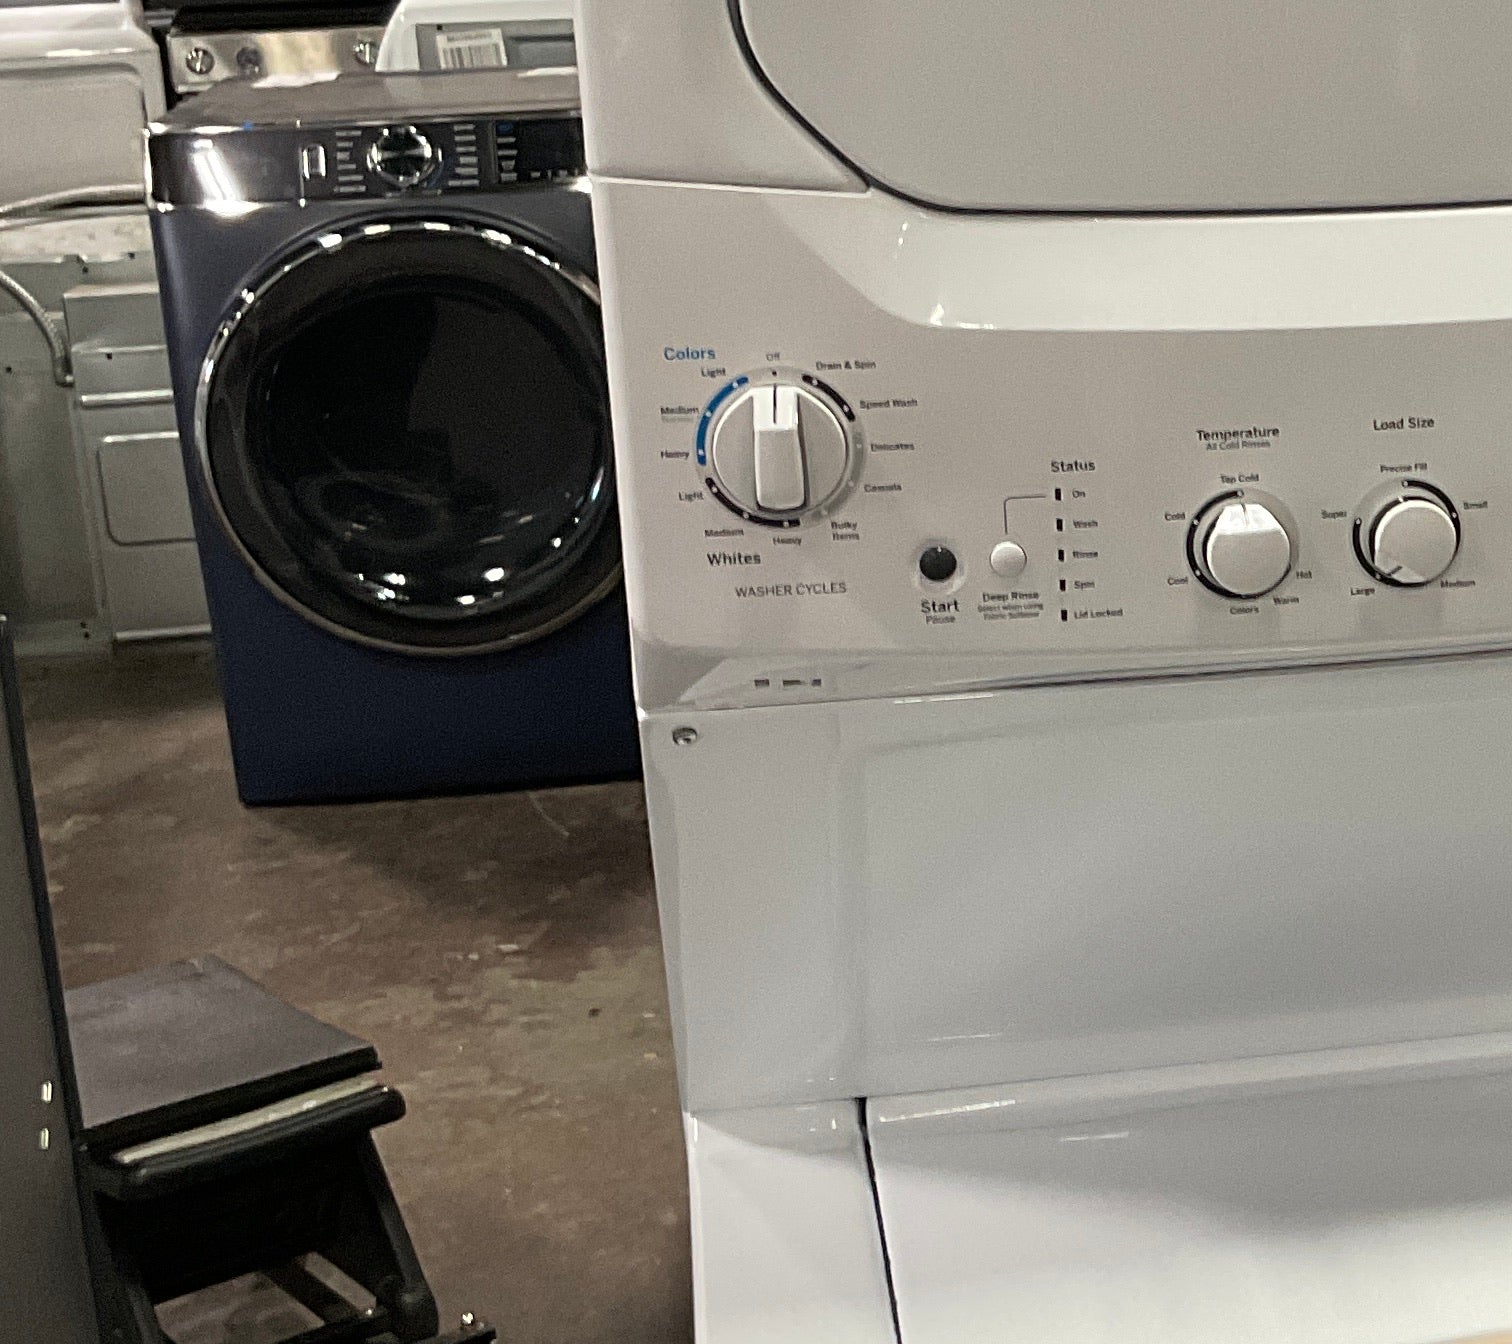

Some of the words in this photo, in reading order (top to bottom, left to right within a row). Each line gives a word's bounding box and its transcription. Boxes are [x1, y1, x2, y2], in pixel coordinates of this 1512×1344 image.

[664, 346, 716, 361] Colors
[1373, 418, 1404, 431] Load
[1408, 417, 1435, 429] Size
[1197, 426, 1280, 442] Temperature
[1051, 460, 1096, 473] Status
[1072, 488, 1086, 498] On
[707, 552, 762, 566] Whites
[736, 585, 793, 598] WASHER
[796, 582, 847, 596] CYCLES
[921, 599, 960, 613] Start
